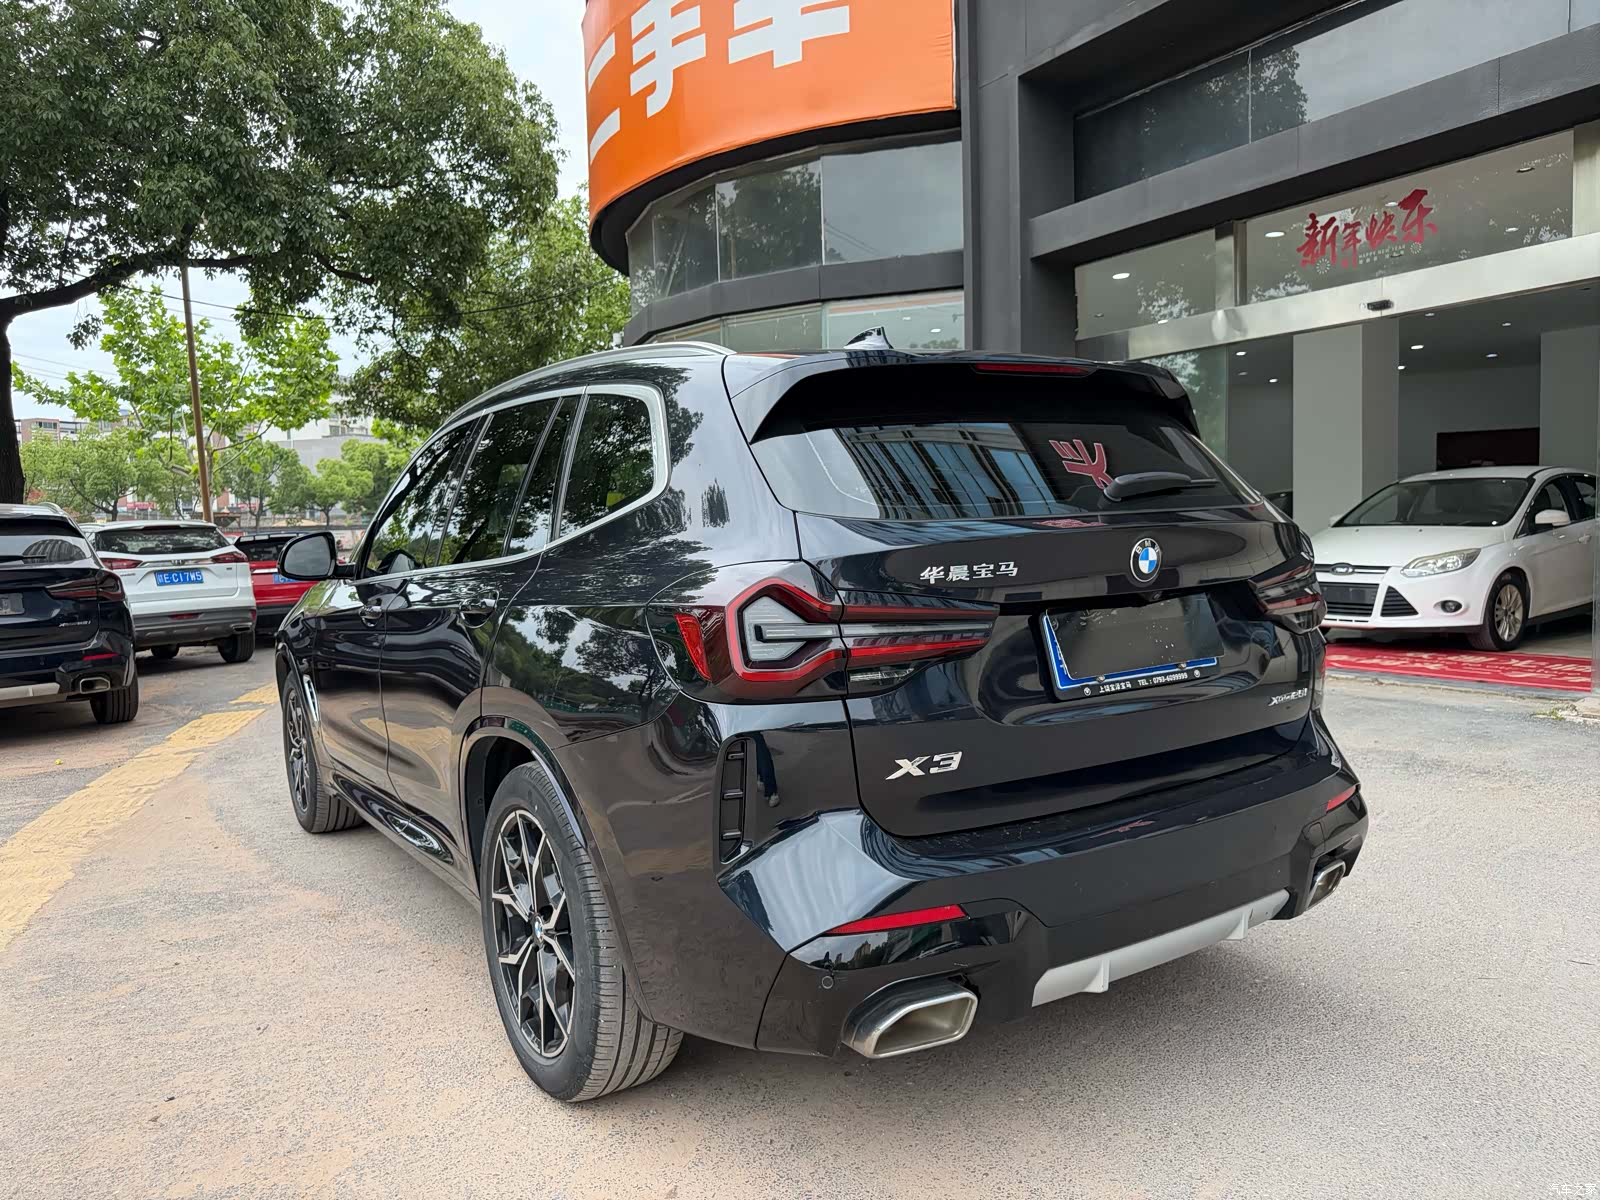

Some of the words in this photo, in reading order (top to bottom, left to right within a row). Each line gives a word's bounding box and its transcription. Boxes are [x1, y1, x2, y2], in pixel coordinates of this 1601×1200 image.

[1297, 189, 1438, 269] 新年快乐
[1135, 540, 1159, 554] BMW
[919, 561, 1020, 584] 华晨宝马
[886, 751, 963, 780] X3
